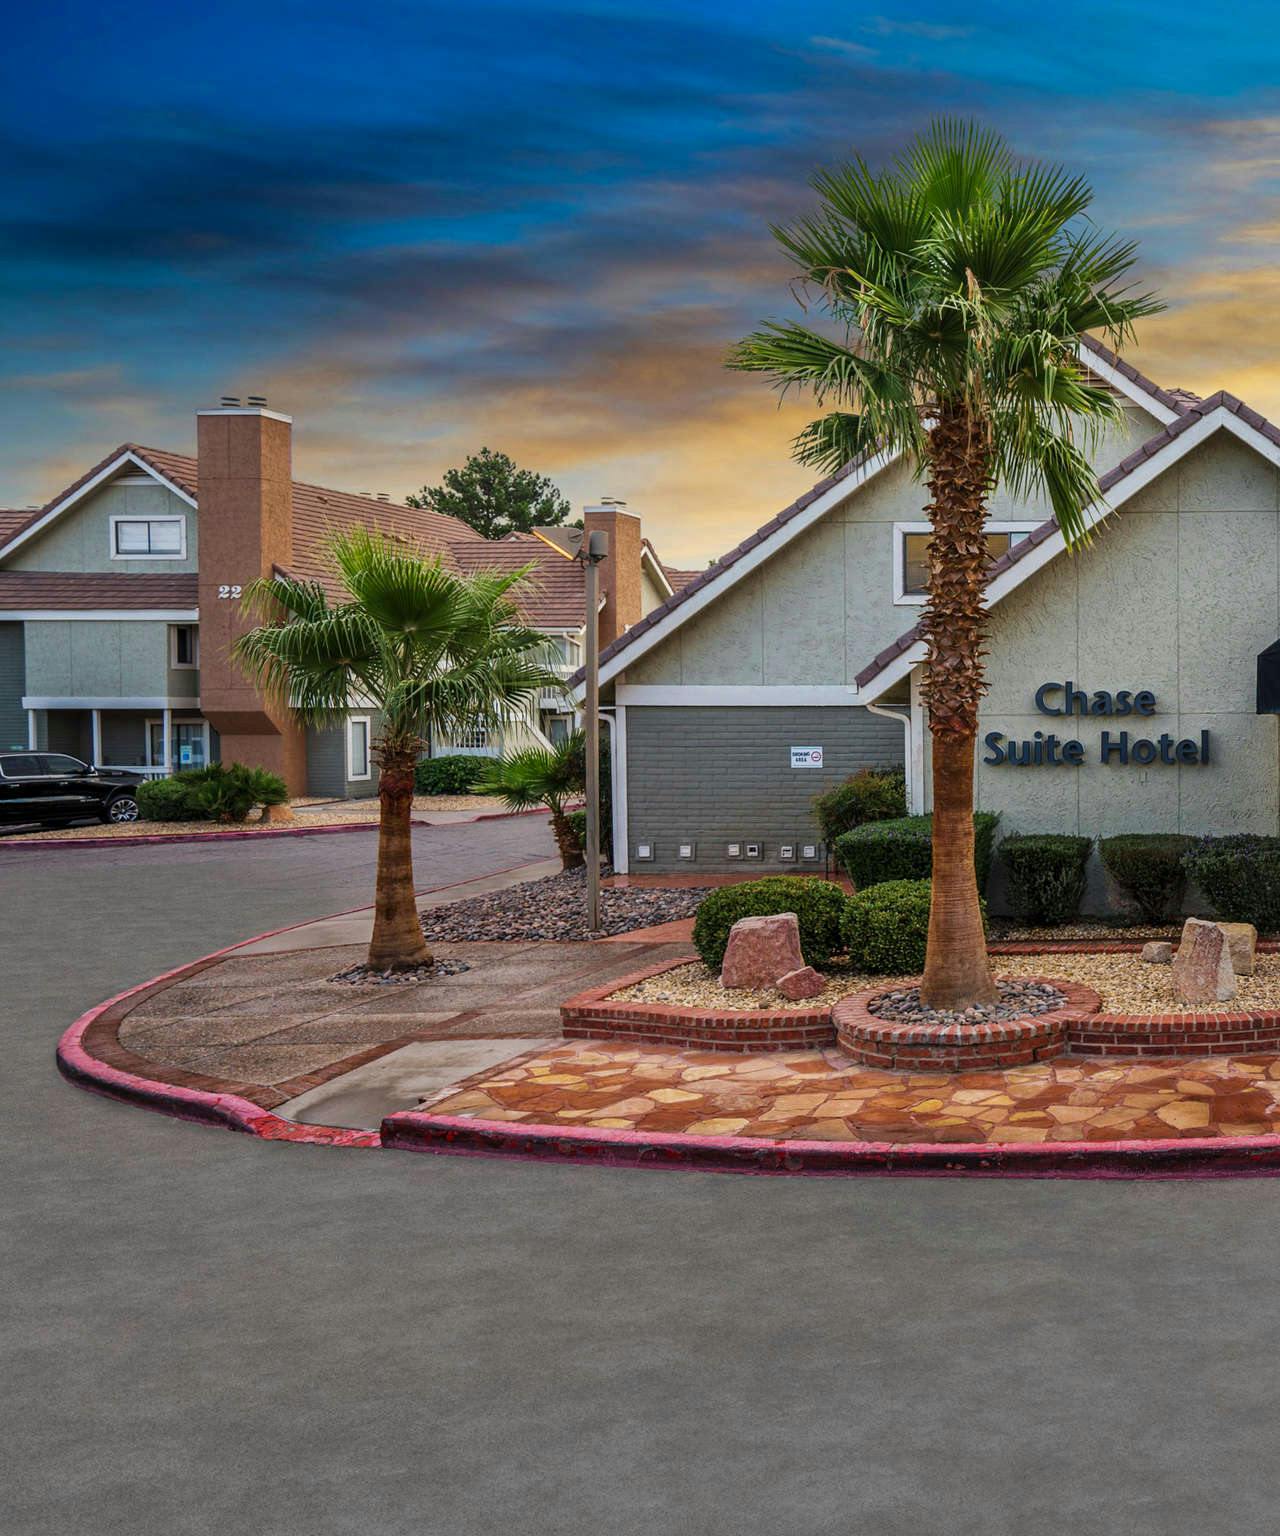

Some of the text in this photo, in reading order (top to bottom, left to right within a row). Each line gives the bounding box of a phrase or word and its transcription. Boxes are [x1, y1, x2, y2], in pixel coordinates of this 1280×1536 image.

[217, 585, 242, 600] 22
[1035, 681, 1157, 717] Chase
[983, 729, 1211, 766] Suite Hotel
